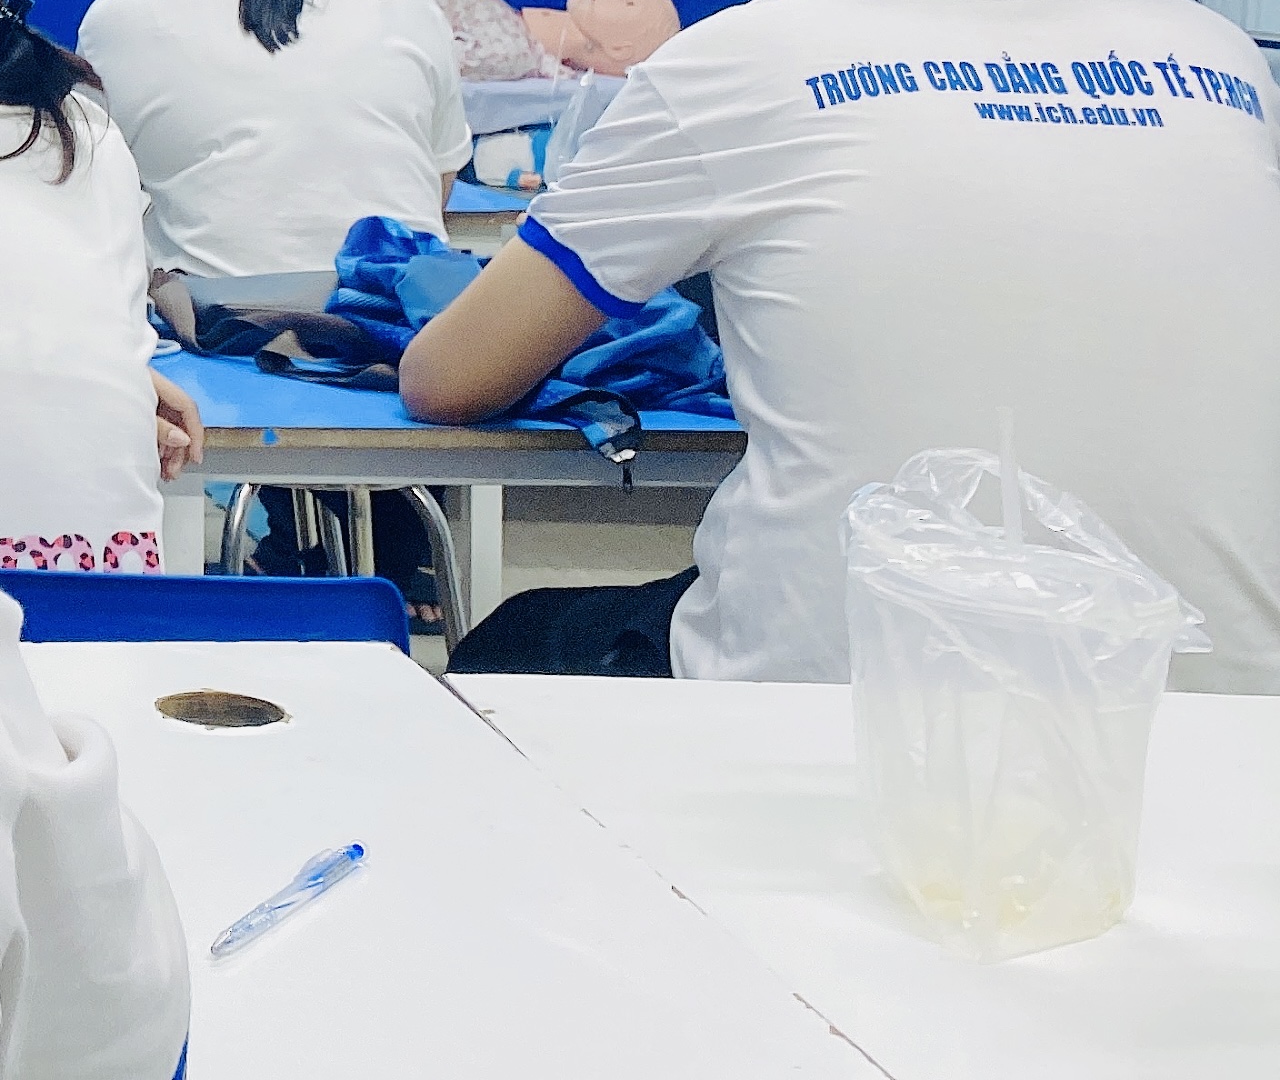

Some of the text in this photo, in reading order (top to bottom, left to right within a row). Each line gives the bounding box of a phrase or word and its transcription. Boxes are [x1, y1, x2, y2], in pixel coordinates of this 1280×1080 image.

[805, 61, 918, 110] TRƯỜNG
[923, 61, 983, 92] CAO
[984, 51, 1068, 95] ĐẲNG
[1071, 50, 1154, 99] QUỐC
[1153, 52, 1194, 98] TẾ
[974, 100, 1164, 127] www.ich.edu.vn
